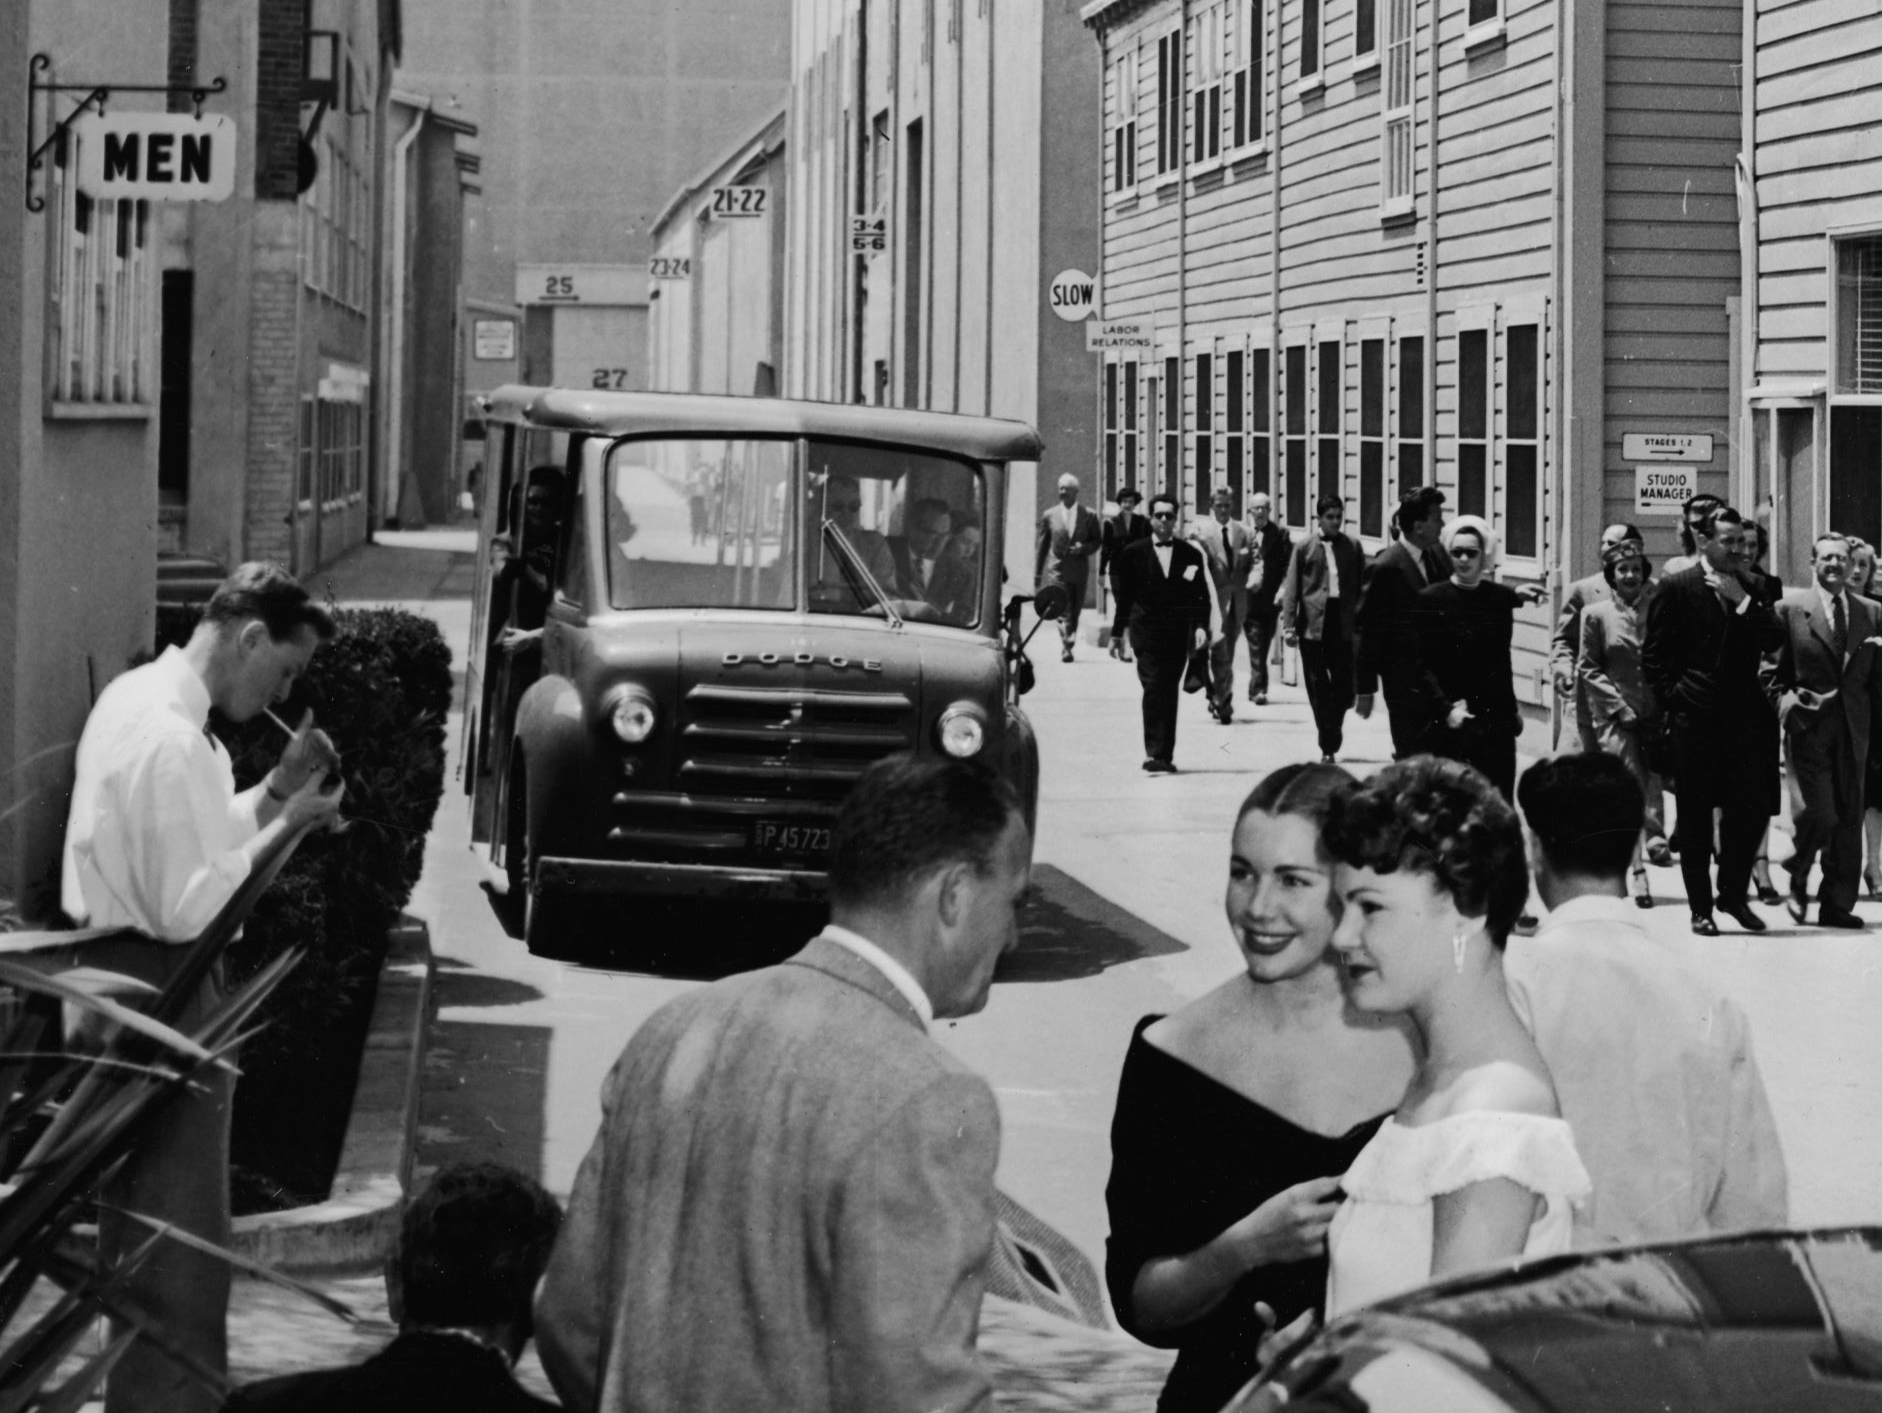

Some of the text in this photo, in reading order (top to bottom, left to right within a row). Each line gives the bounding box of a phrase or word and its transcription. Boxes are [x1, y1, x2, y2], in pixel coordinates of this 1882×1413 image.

[103, 133, 212, 183] MEN
[545, 276, 573, 294] 25
[1053, 284, 1094, 306] SLOW
[1103, 326, 1140, 335] LABOR
[1092, 338, 1151, 347] RELATIONS
[592, 368, 628, 389] 27
[1647, 474, 1687, 486] STUDIO
[1640, 488, 1693, 500] MANAGER
[722, 652, 882, 671] DODGE
